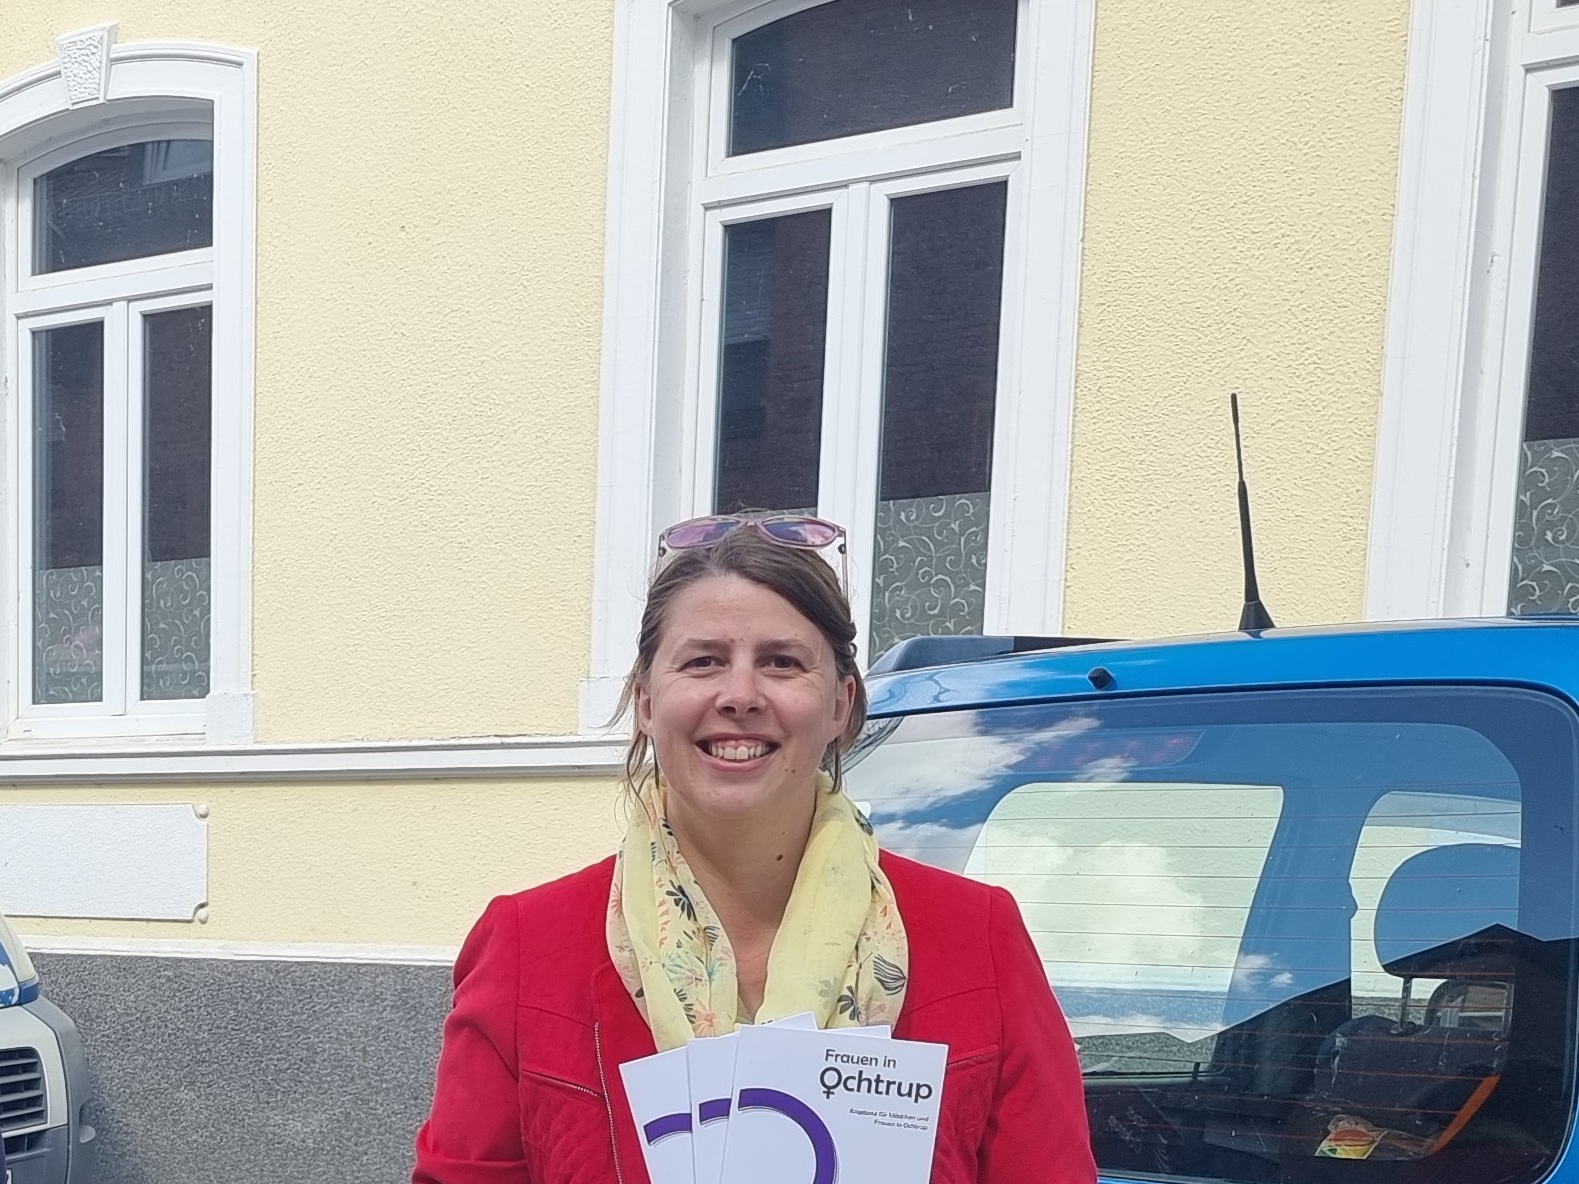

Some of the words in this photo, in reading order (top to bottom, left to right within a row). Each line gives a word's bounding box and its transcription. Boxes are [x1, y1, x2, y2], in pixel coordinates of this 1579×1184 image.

[824, 1048, 879, 1067] Frauen
[882, 1055, 897, 1069] in
[819, 1066, 933, 1104] Ochtrup
